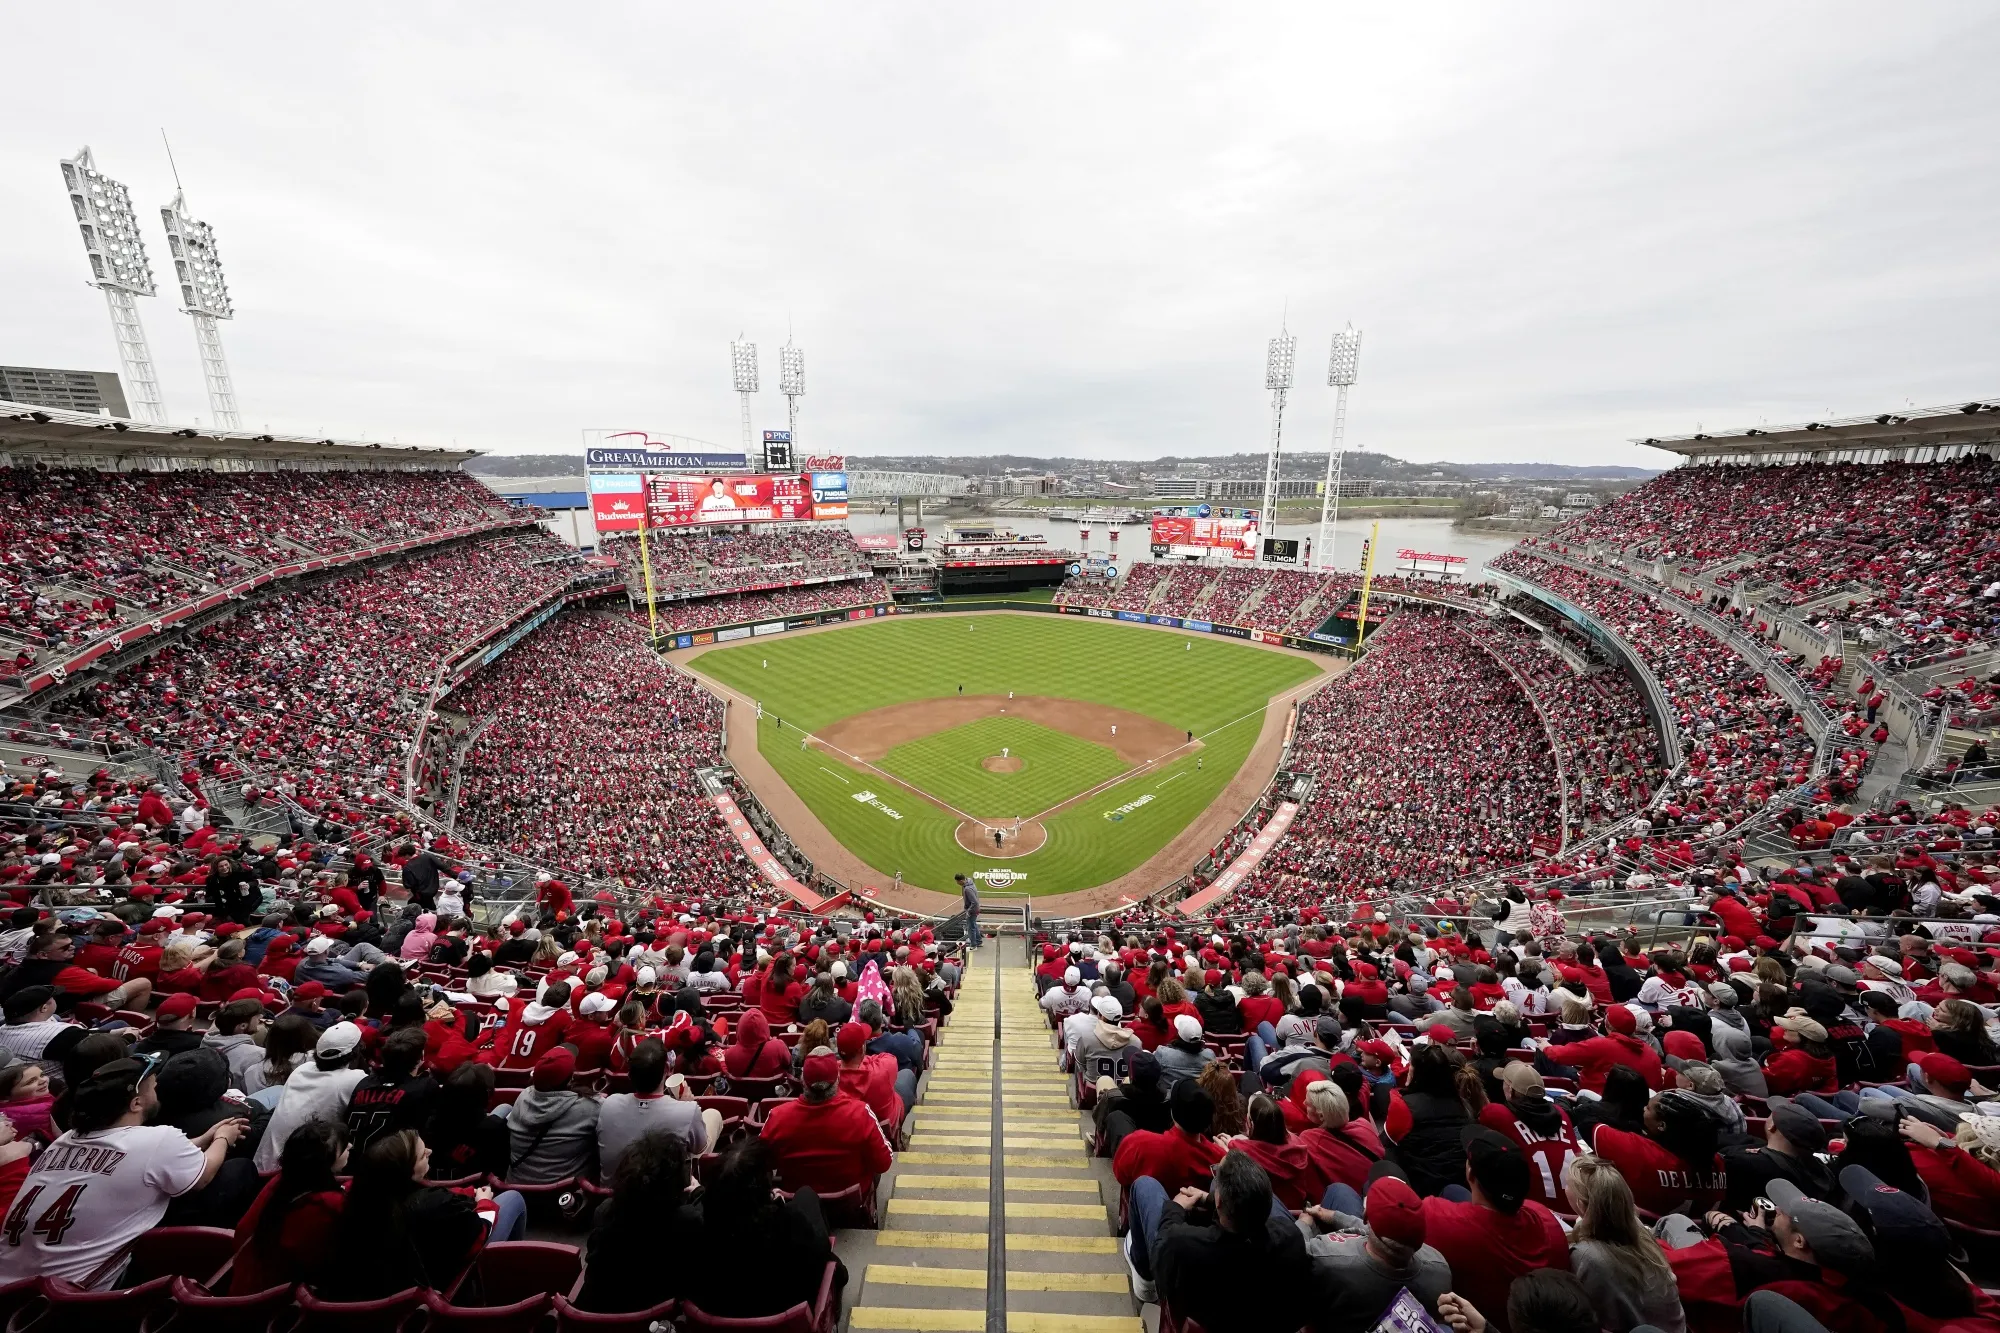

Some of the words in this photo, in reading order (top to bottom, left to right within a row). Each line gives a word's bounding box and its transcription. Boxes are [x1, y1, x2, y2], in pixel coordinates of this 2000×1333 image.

[590, 449, 639, 463] GREAT
[635, 454, 704, 467] AMERICAN
[806, 455, 844, 470] Coca-Cola
[596, 512, 645, 521] Budweiser
[1263, 554, 1296, 563] BETMGM
[1313, 632, 1342, 643] GEICO
[972, 871, 1010, 880] OPENING
[1010, 872, 1028, 880] DAY
[1943, 925, 1970, 933] CASEY
[1523, 993, 1536, 1012] 4
[510, 1028, 537, 1057] 19
[354, 1088, 406, 1105] MILLER
[3, 1183, 88, 1247] 44
